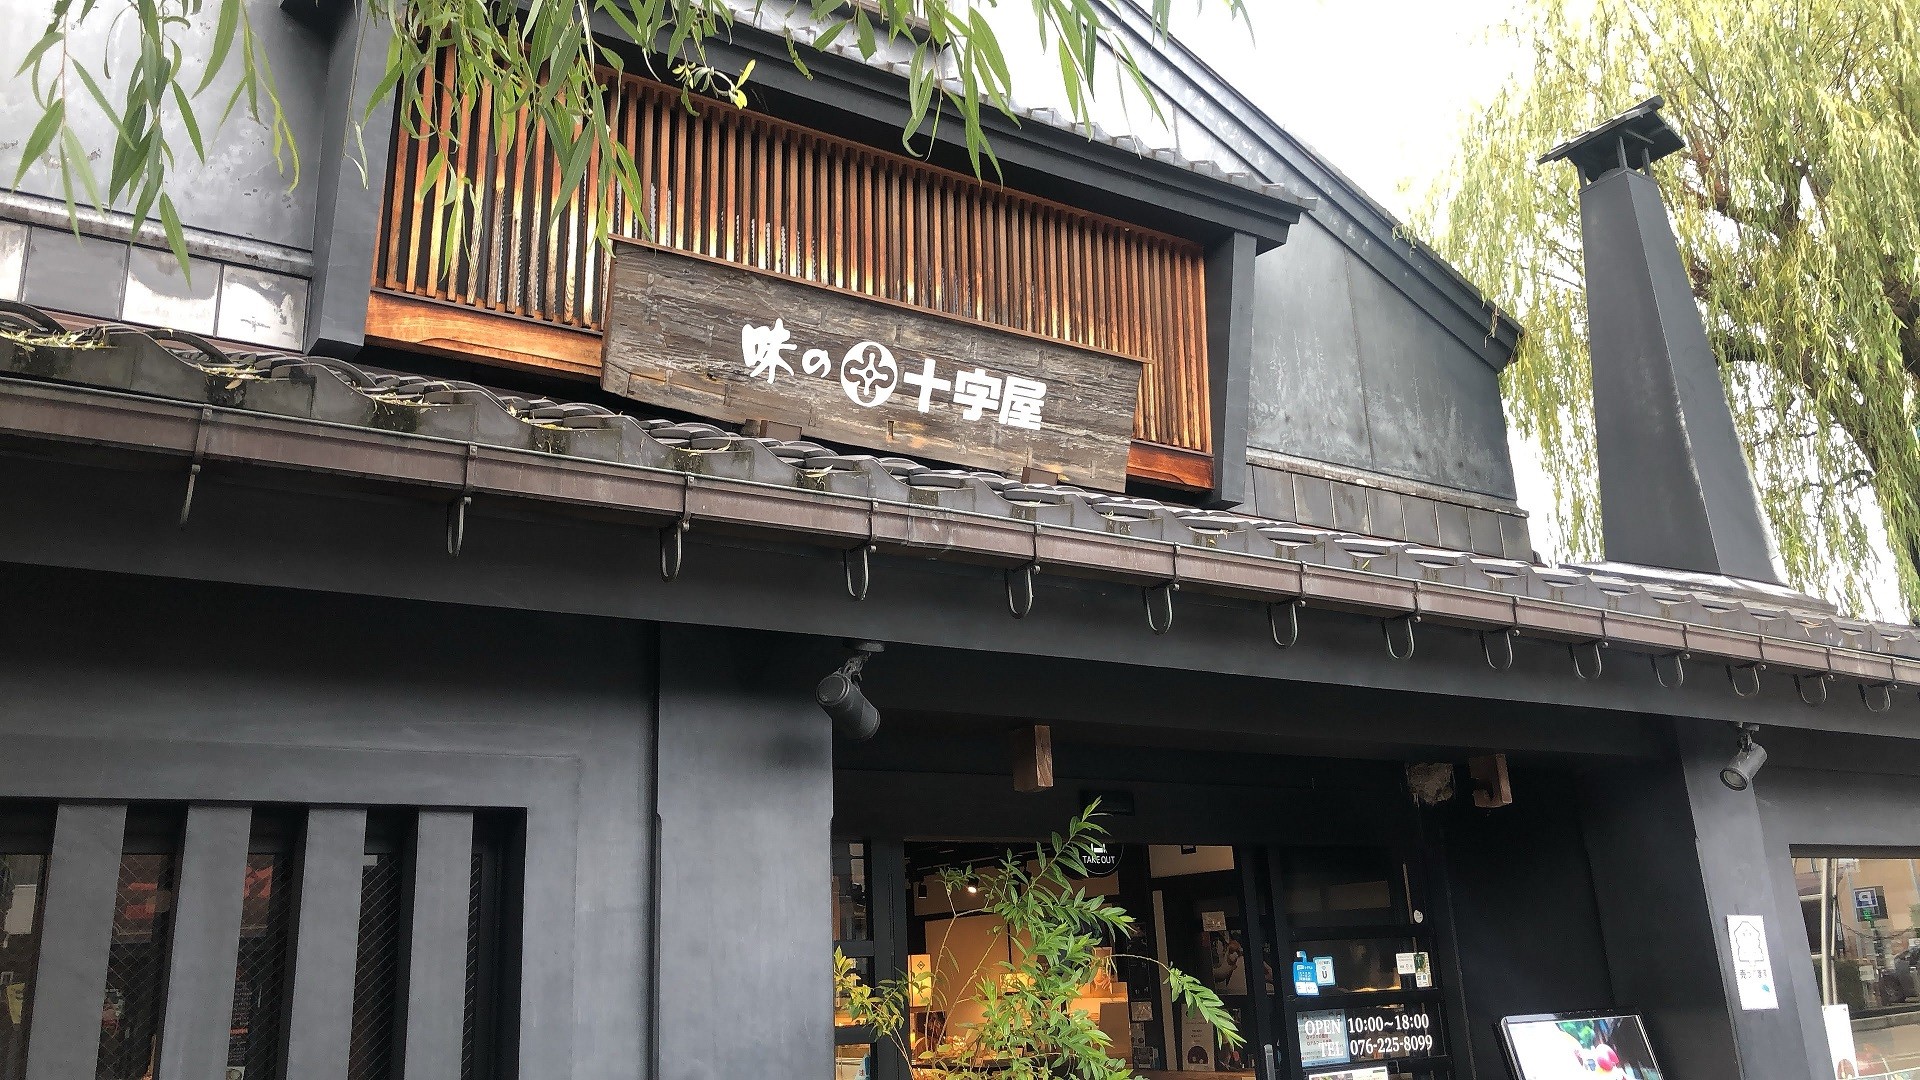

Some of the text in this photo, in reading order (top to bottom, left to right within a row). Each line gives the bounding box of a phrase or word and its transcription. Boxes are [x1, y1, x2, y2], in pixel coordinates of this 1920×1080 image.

[741, 318, 1047, 431] 味の 十字屋
[1739, 969, 1768, 980] 売っます
[1305, 1019, 1341, 1036] OPEN
[1319, 1041, 1344, 1058] TEL
[1350, 1034, 1433, 1056] 076-225-8099
